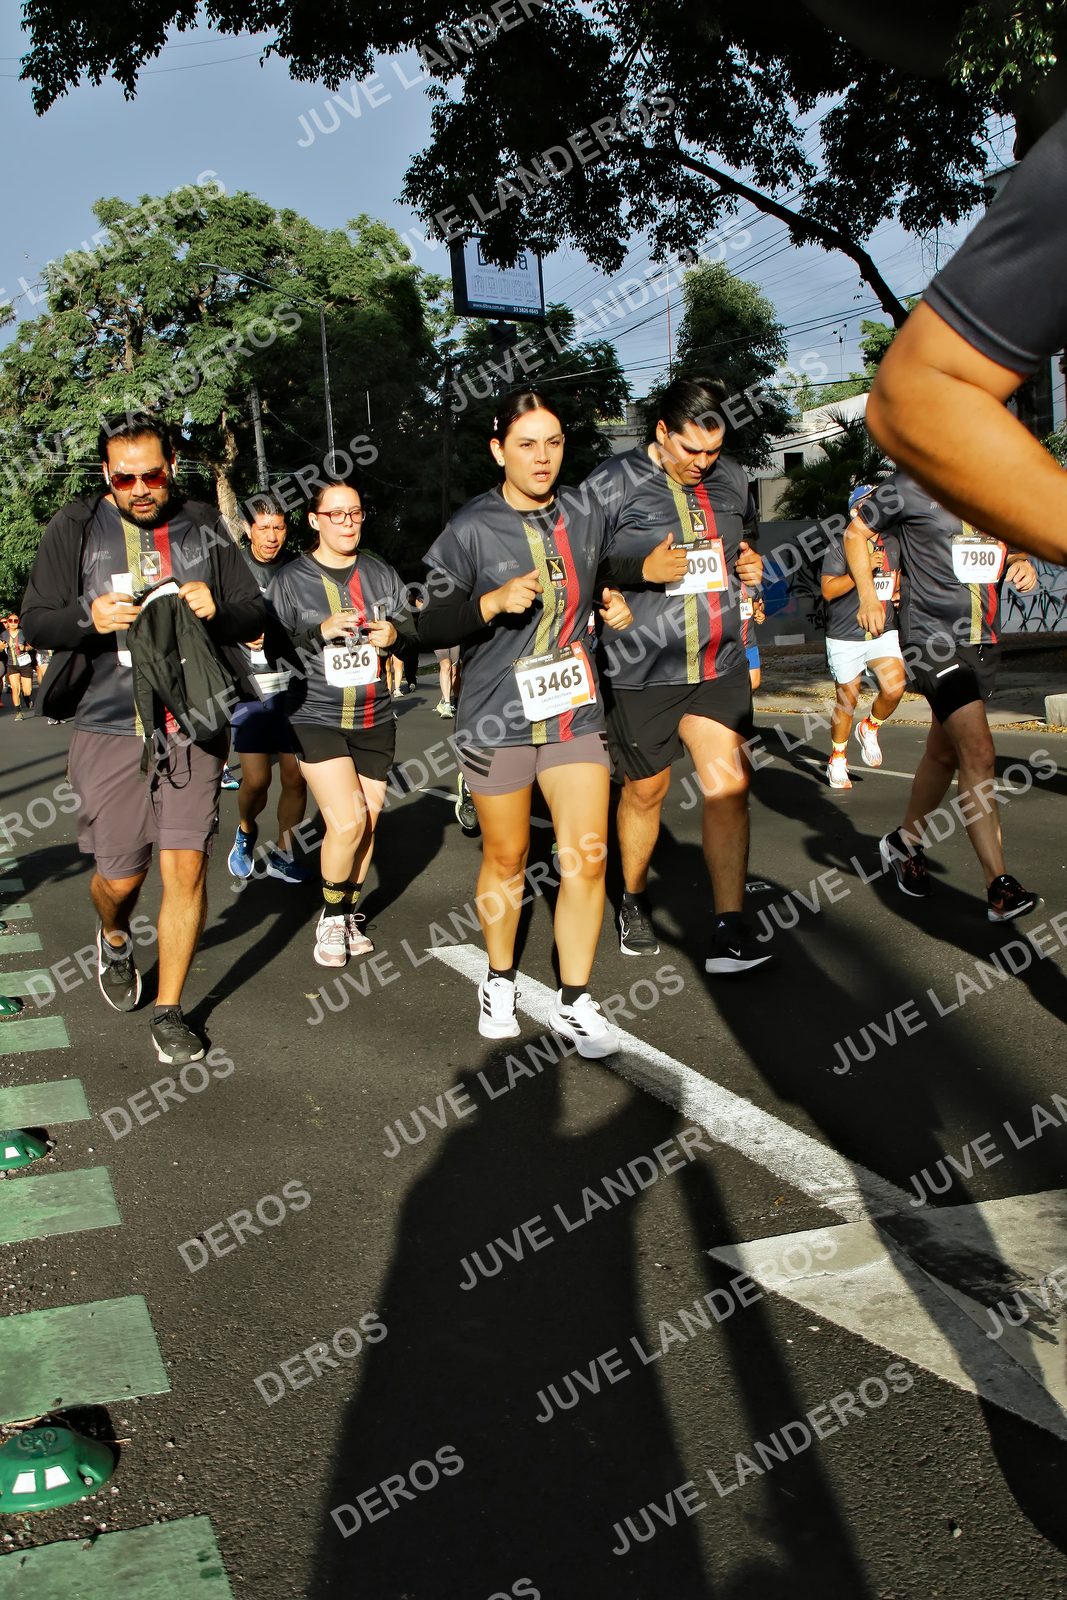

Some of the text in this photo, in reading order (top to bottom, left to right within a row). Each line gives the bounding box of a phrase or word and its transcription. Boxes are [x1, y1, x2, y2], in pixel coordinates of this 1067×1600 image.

[687, 556, 718, 575] 090
[961, 551, 996, 566] 7980
[875, 580, 890, 590] 007
[332, 650, 371, 670] 8526
[522, 664, 583, 699] 13465
